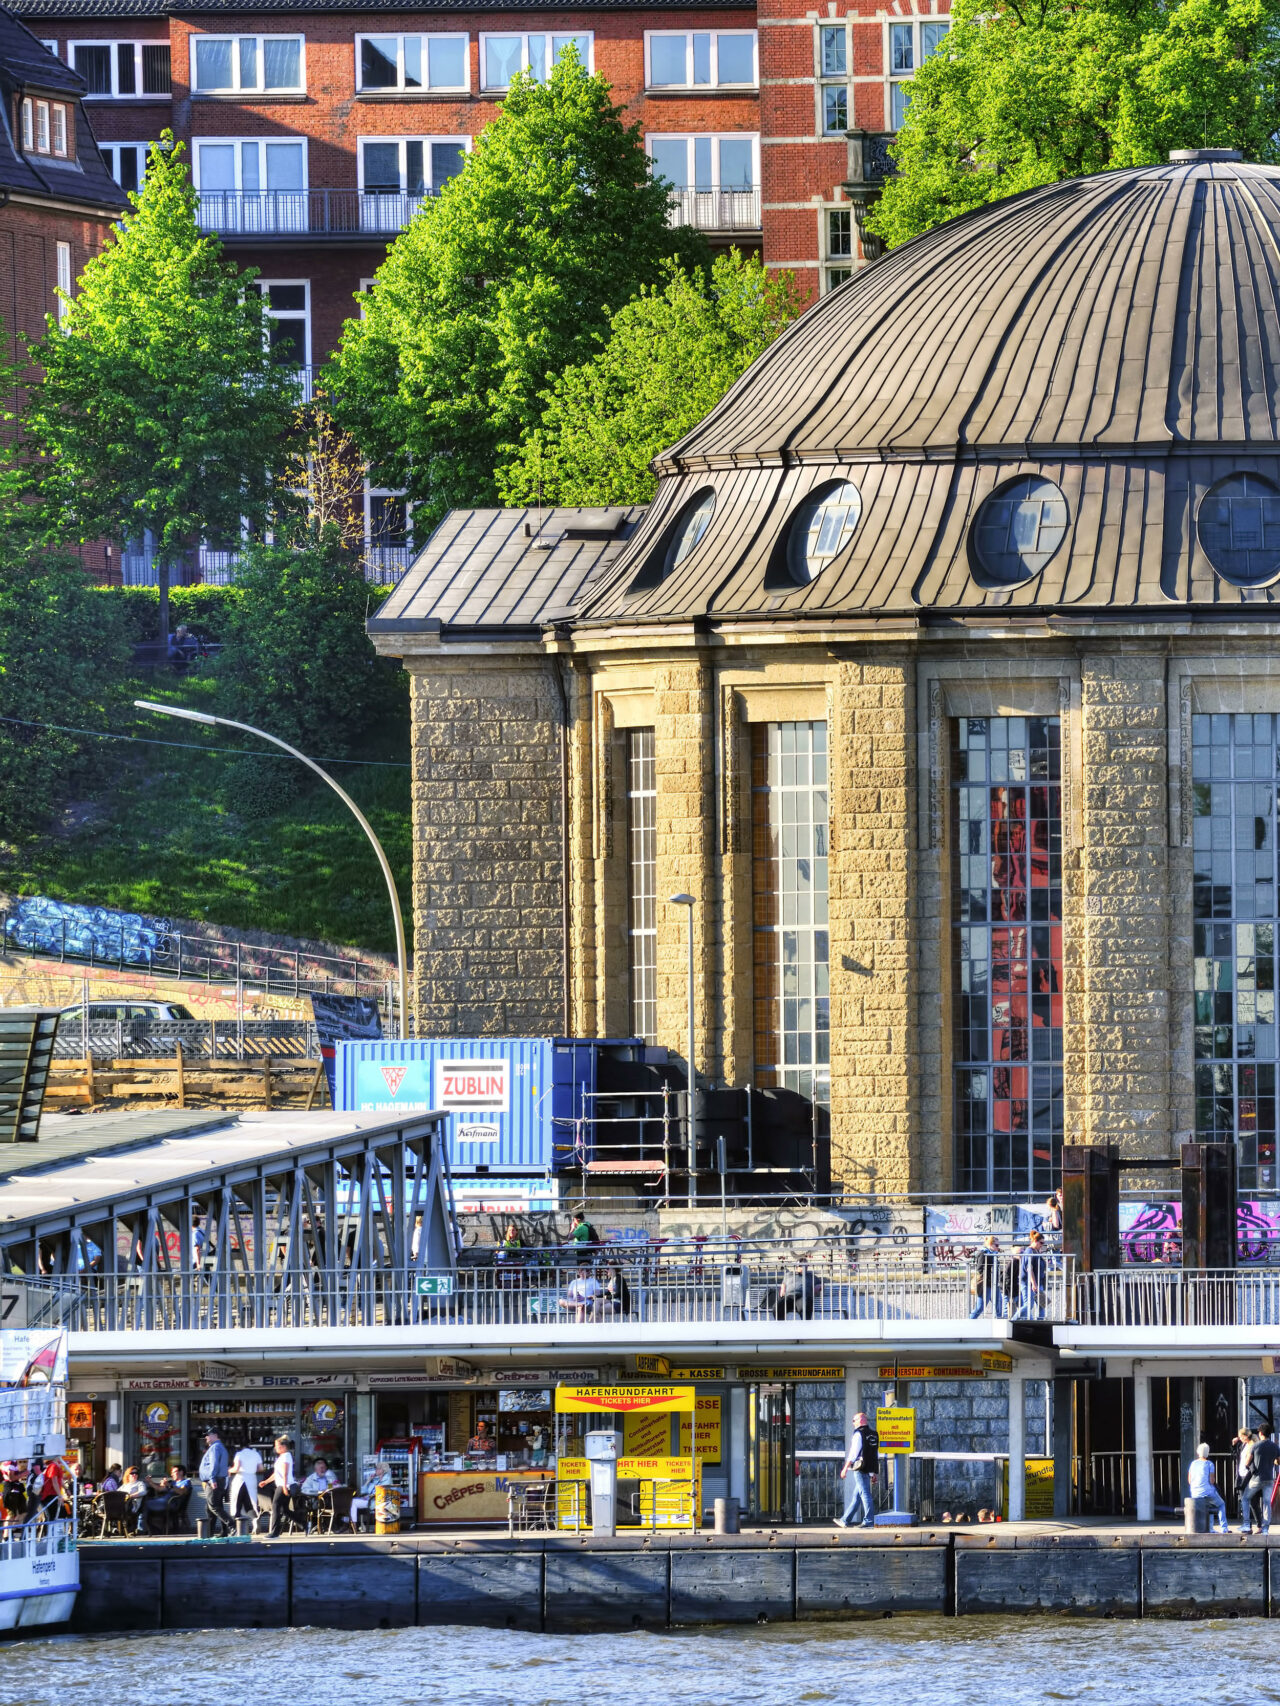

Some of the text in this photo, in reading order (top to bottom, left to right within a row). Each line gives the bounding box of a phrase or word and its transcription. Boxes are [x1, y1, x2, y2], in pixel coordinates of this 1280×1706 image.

[1, 1295, 19, 1320] 7
[495, 1371, 539, 1381] CRÊPES
[689, 1369, 721, 1378] KASSE
[739, 1368, 841, 1378] GROSSE HAFENRUNDFAHRT
[129, 1379, 190, 1389] KALTE GETRÄNKE
[262, 1376, 299, 1386] BIER
[576, 1388, 675, 1396] HAFENRUNDFAHRT
[600, 1397, 631, 1405] TICKETS
[695, 1400, 720, 1410] SSE
[681, 1422, 720, 1430] ABFAHRT
[637, 1460, 658, 1468] HIER
[433, 1482, 485, 1510] CRÊPES
